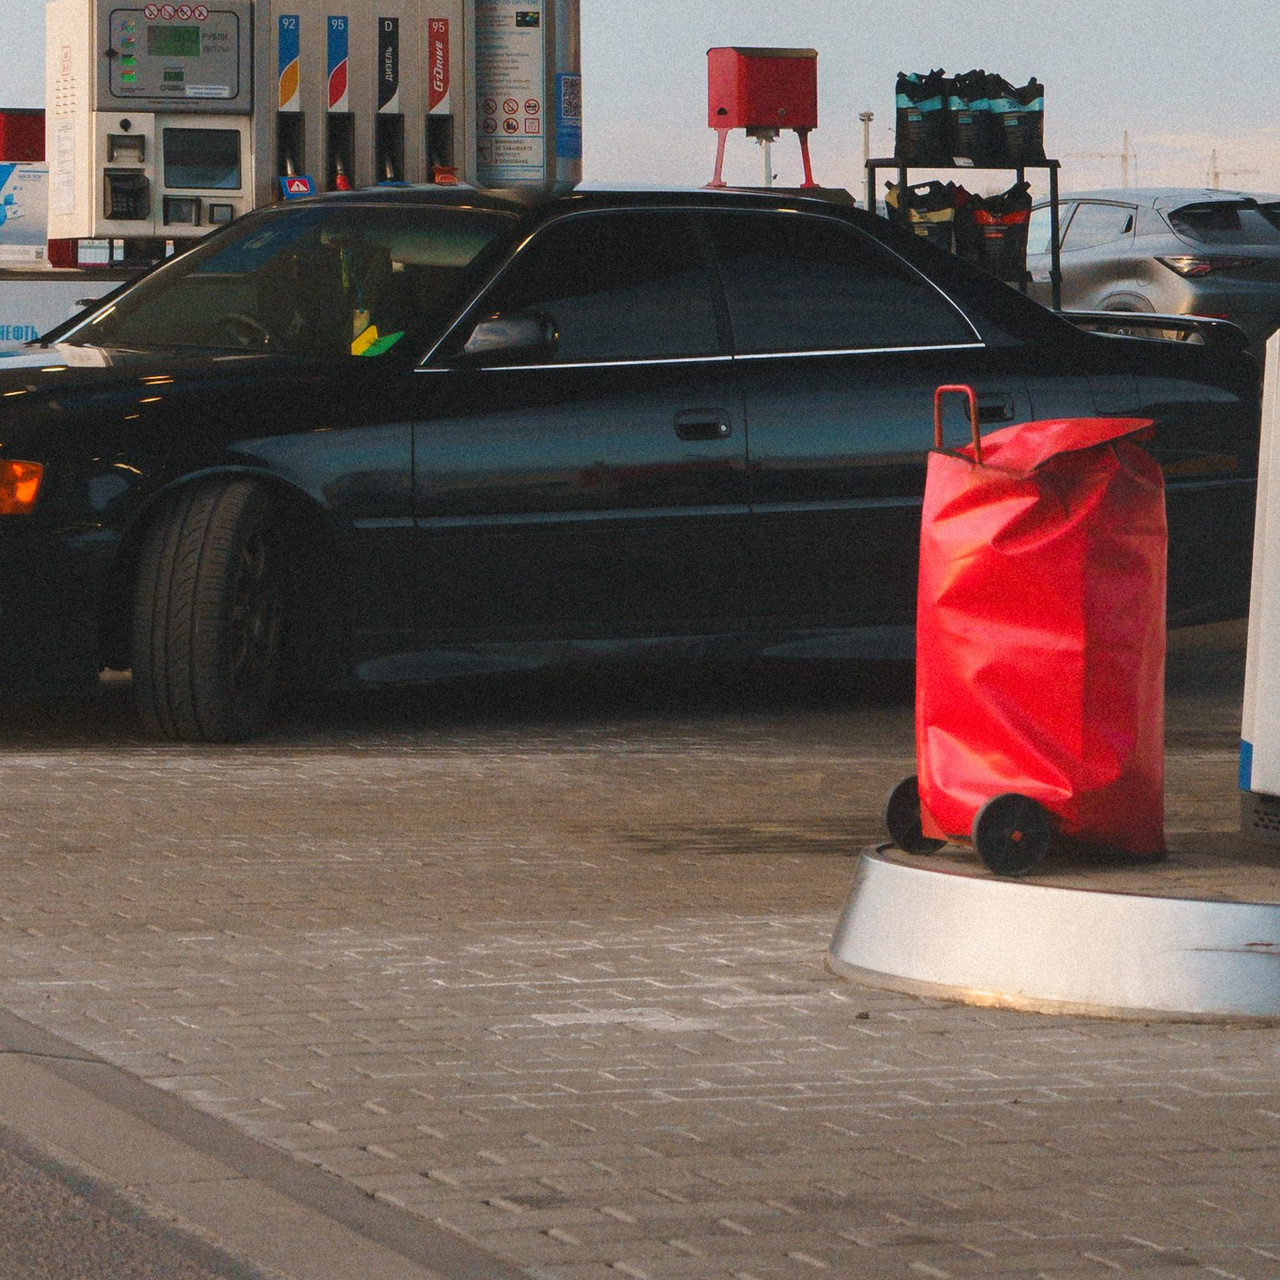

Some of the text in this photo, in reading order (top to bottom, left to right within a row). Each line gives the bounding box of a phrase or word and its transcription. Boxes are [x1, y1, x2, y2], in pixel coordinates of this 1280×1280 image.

[282, 18, 296, 29] 92
[331, 19, 345, 30] 95
[384, 20, 393, 32] D
[432, 21, 445, 33] 95
[385, 46, 393, 82] ДИЗЕЛЬ
